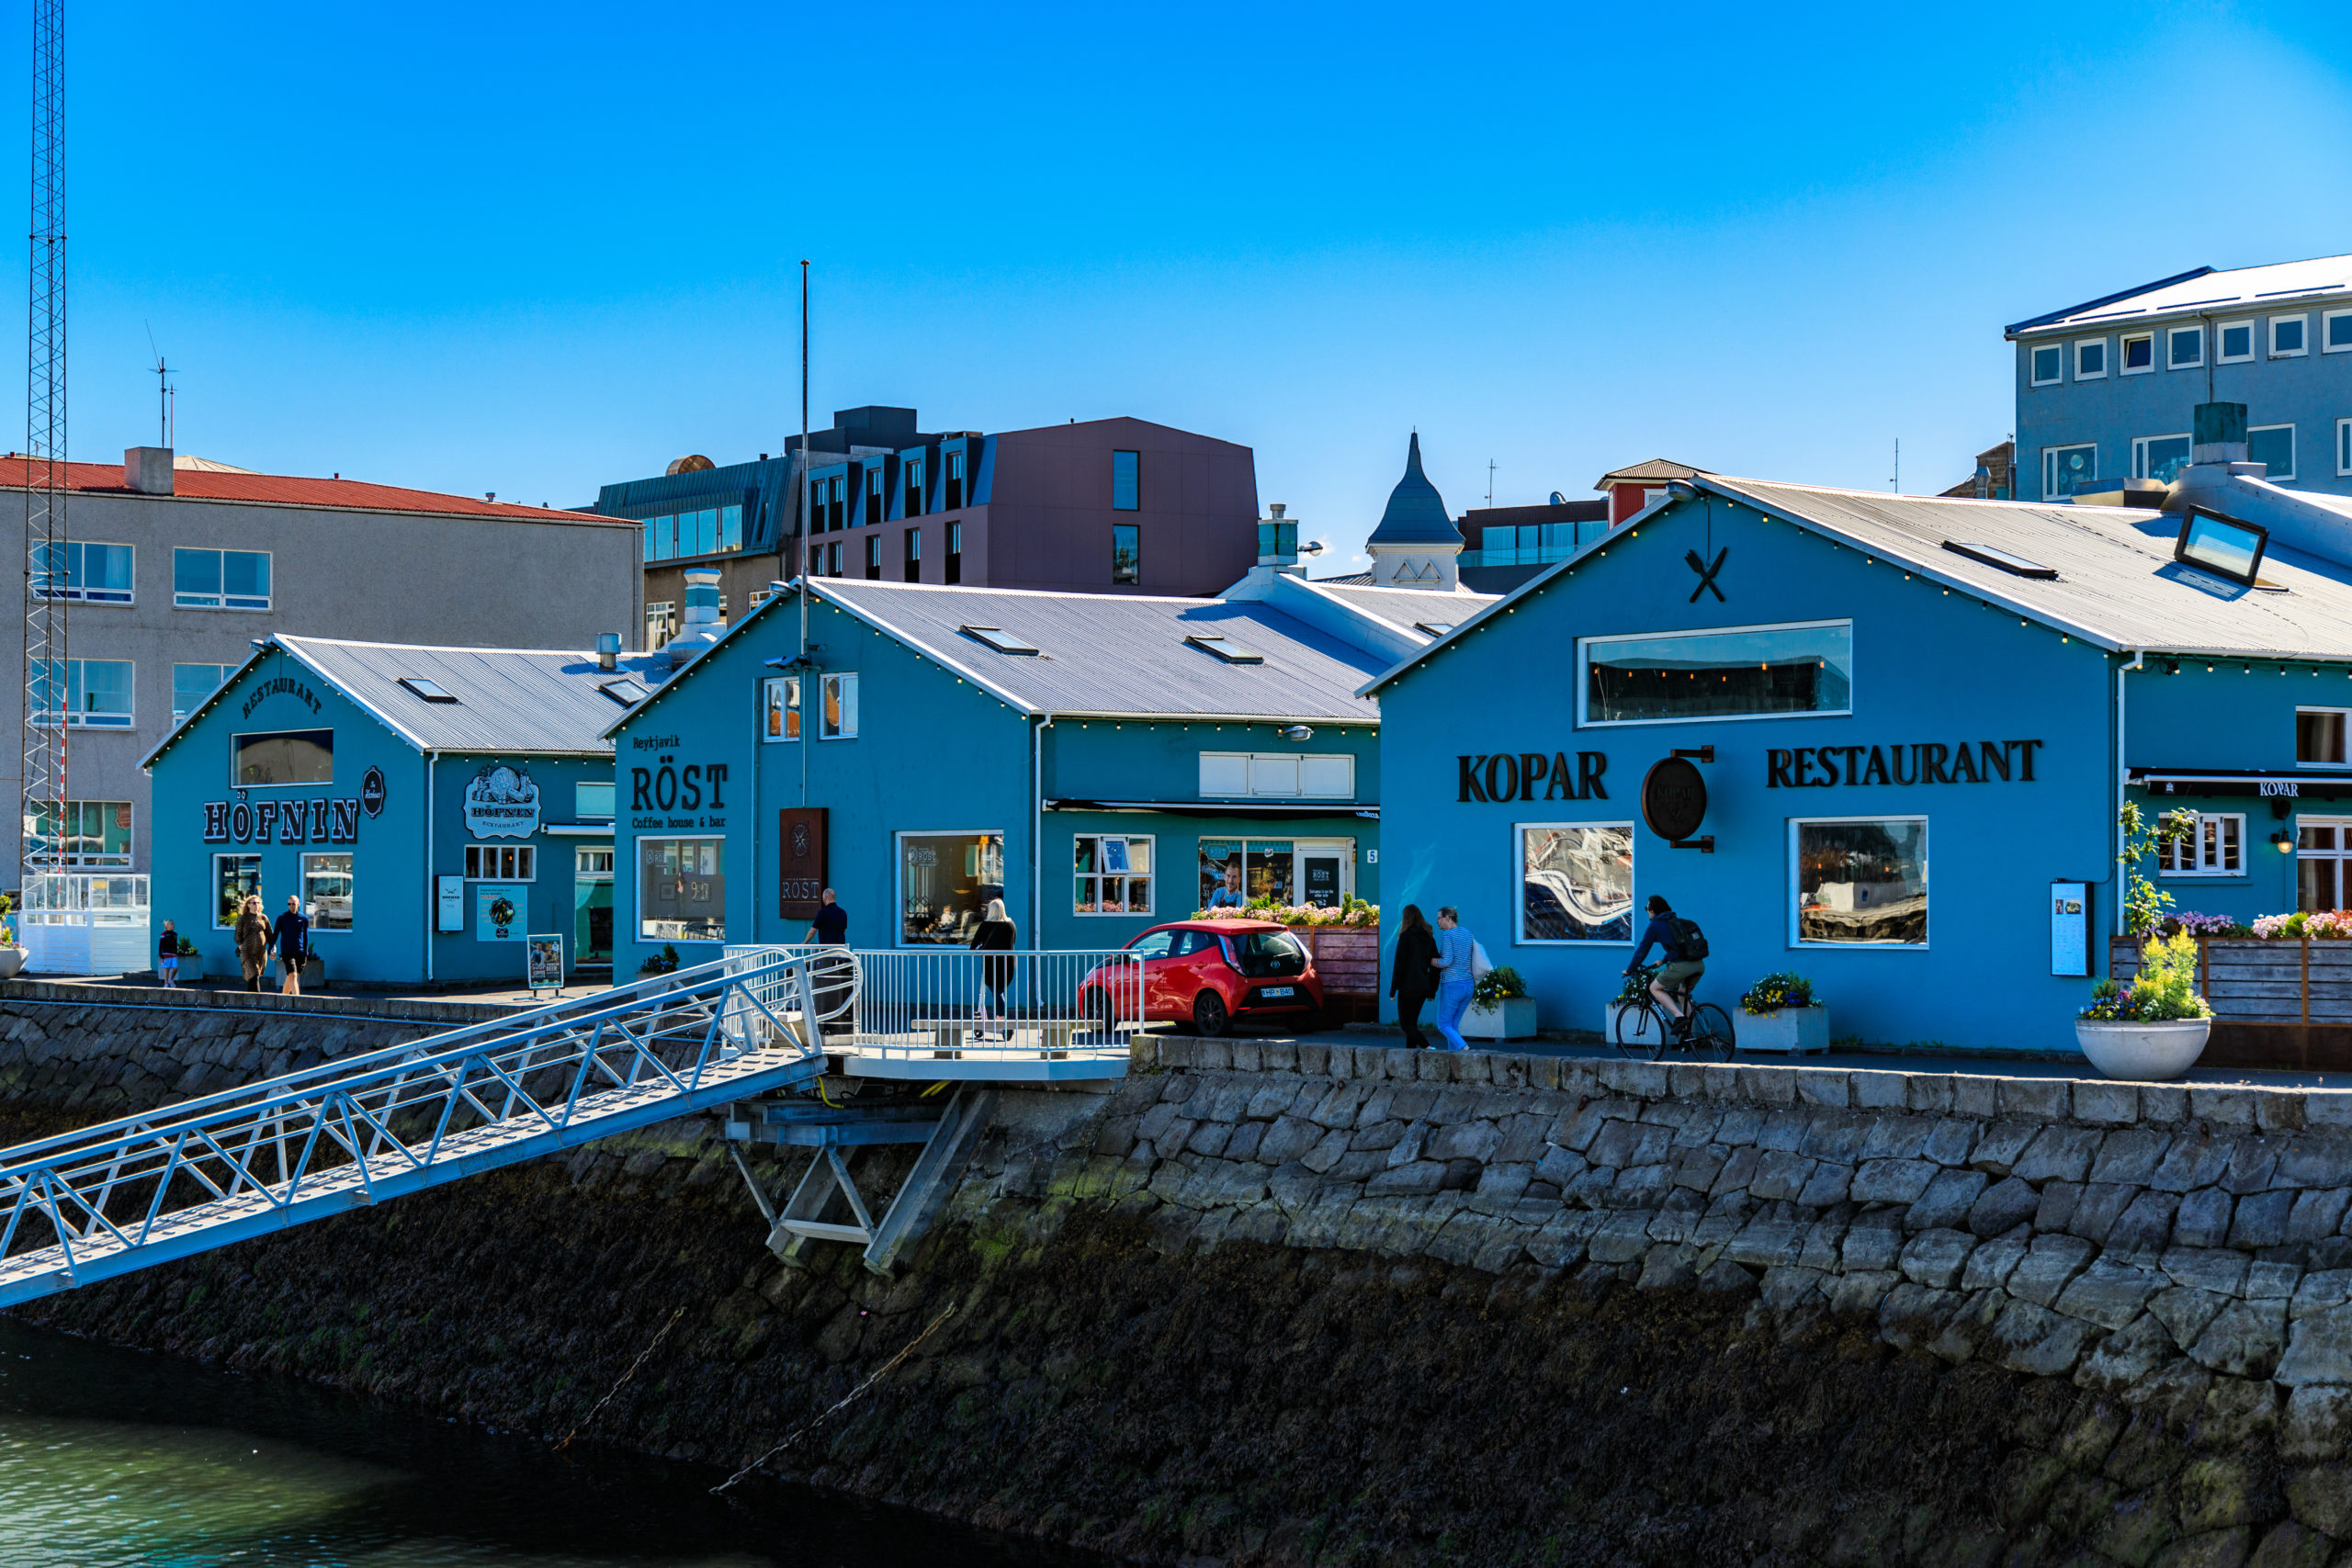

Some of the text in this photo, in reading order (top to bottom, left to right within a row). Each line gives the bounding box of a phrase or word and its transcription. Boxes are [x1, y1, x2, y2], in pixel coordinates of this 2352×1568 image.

[243, 677, 322, 720] RESTAURANT
[633, 734, 680, 751] Reykjavik
[1766, 739, 2042, 788] RESTAURANT
[631, 755, 728, 811] RÖST
[1455, 751, 1610, 803] KOPAR
[2259, 783, 2299, 797] KOPAR
[204, 790, 359, 845] HÖFNIN
[471, 805, 535, 818] HÖFNIN
[632, 815, 726, 829] Coffee house & bar
[1370, 851, 1375, 862] 5
[782, 876, 820, 899] RÖST
